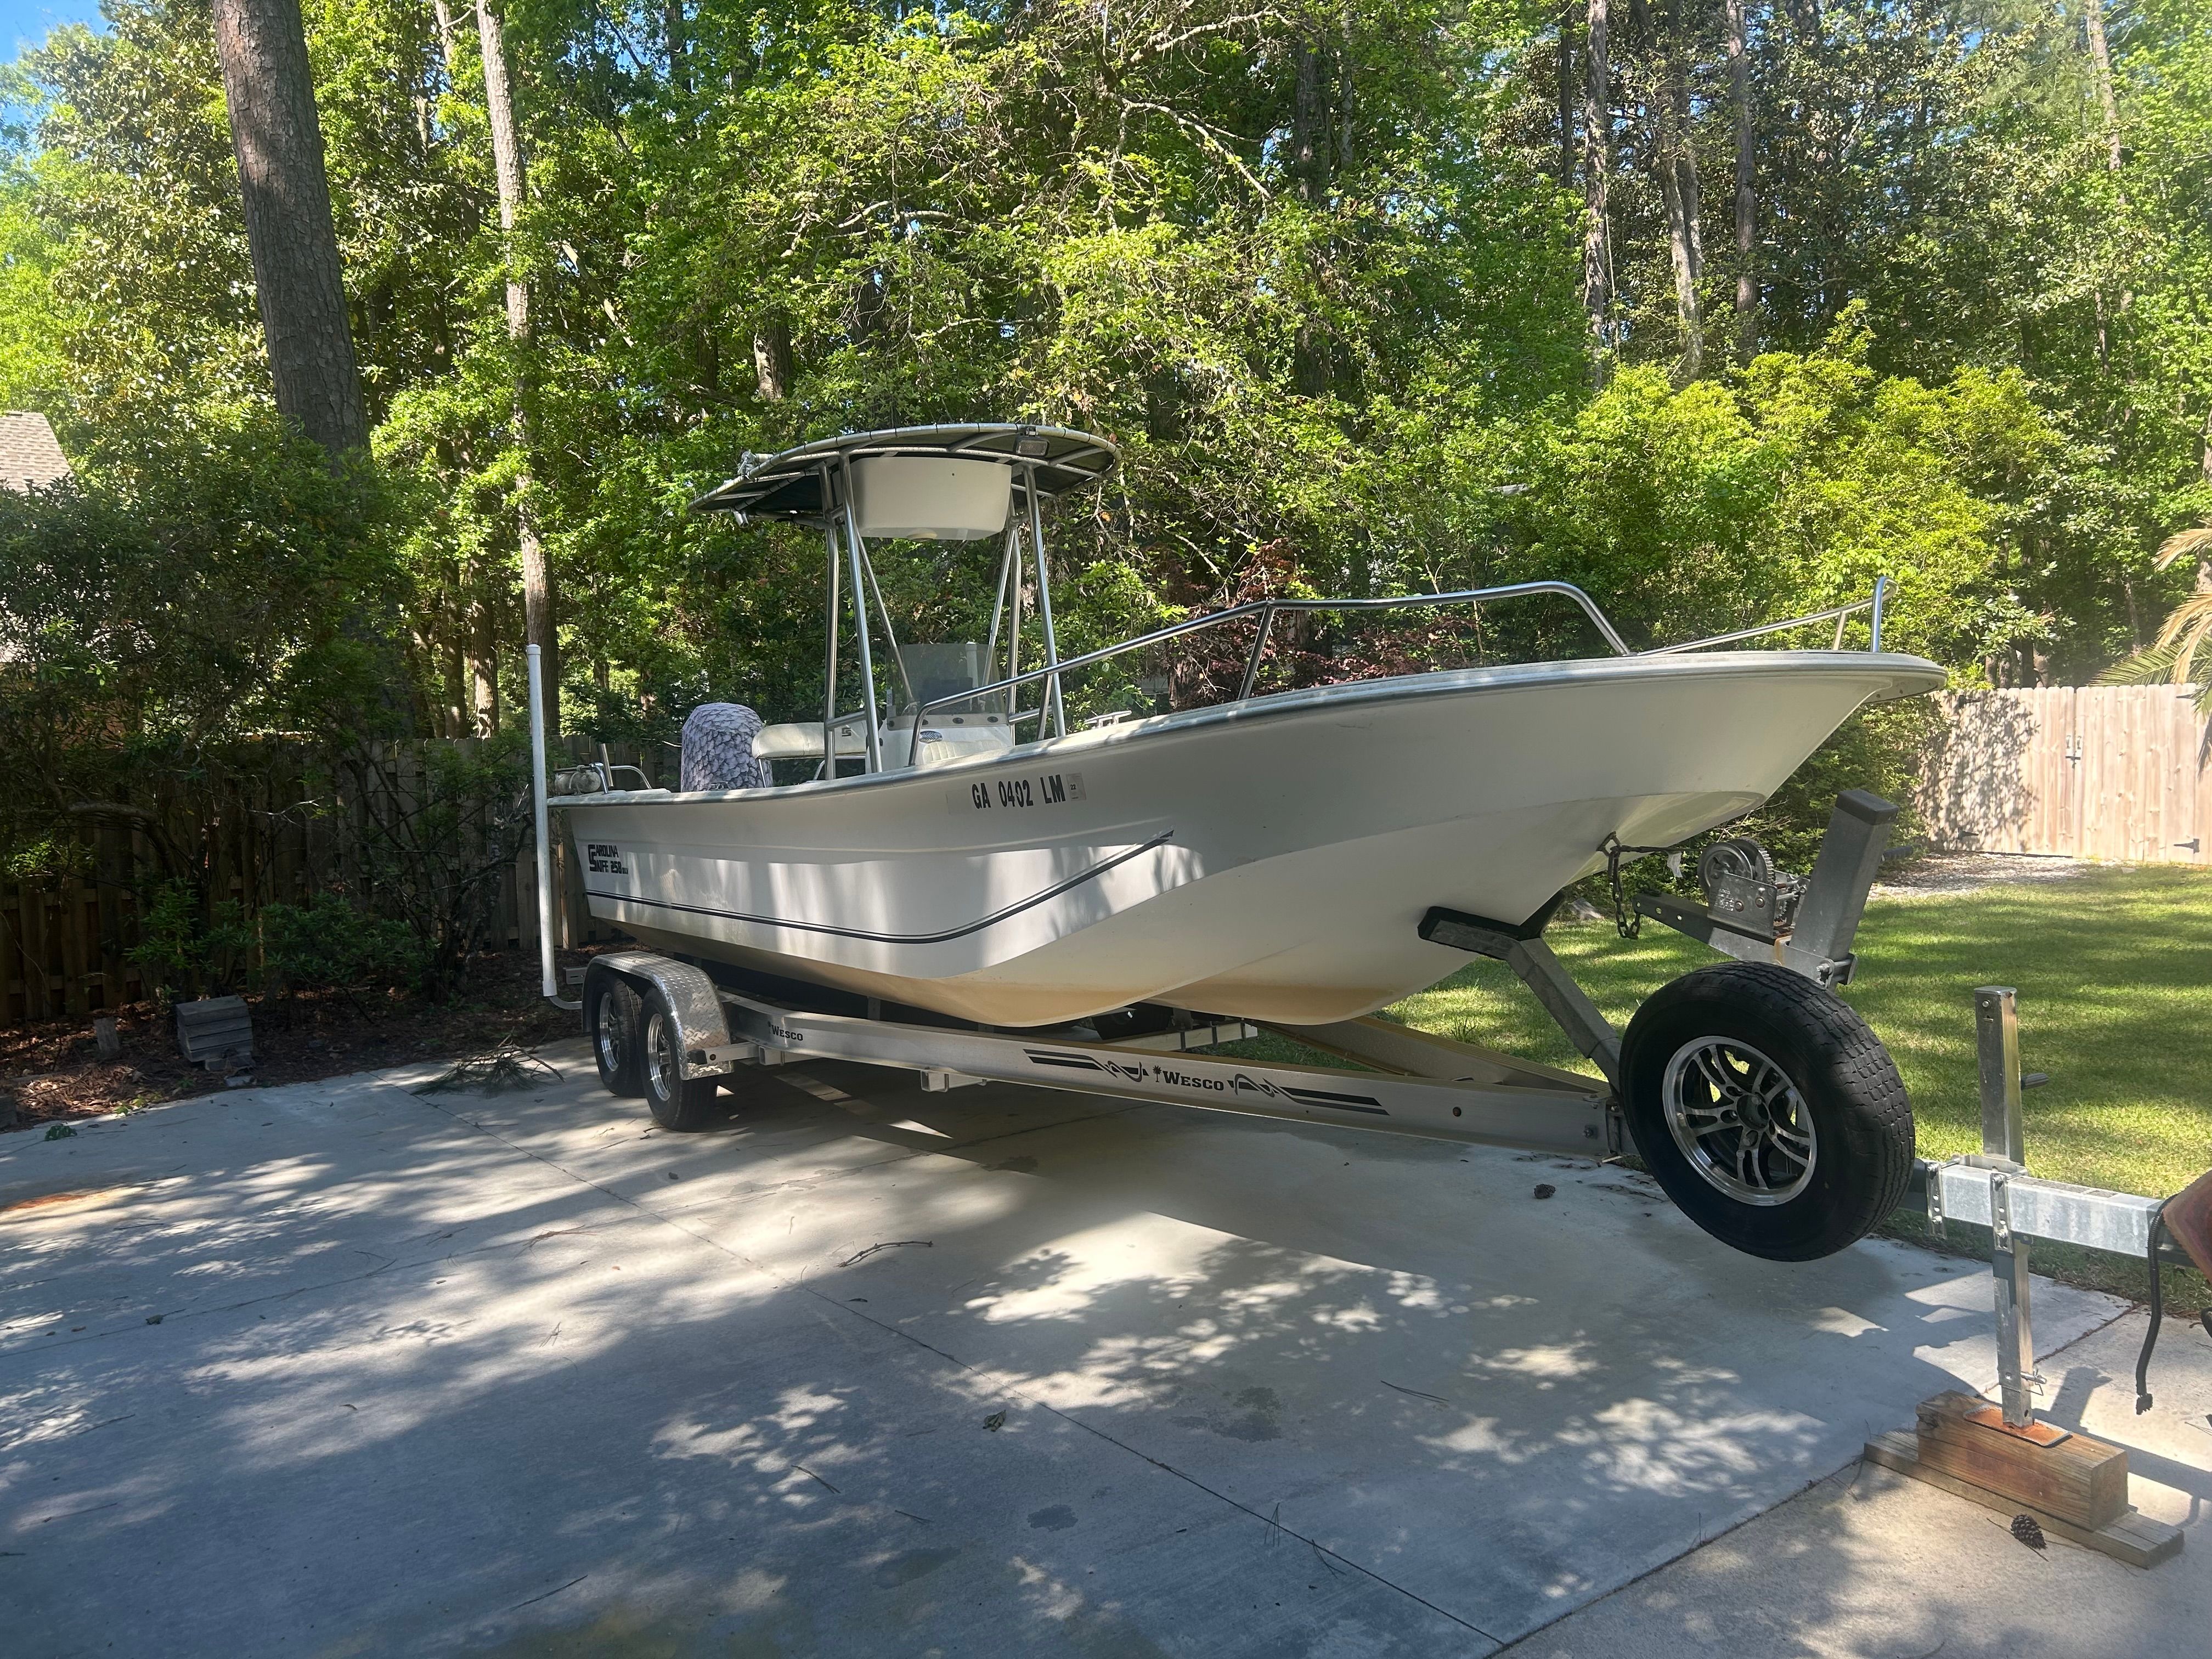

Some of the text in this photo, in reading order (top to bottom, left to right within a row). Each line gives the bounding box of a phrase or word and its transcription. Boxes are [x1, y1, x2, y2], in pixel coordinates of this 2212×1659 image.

[972, 774, 1066, 809] GA 0402 LM
[588, 844, 619, 862] CAROLINA
[589, 855, 609, 873] SKIFF
[610, 860, 622, 873] 258
